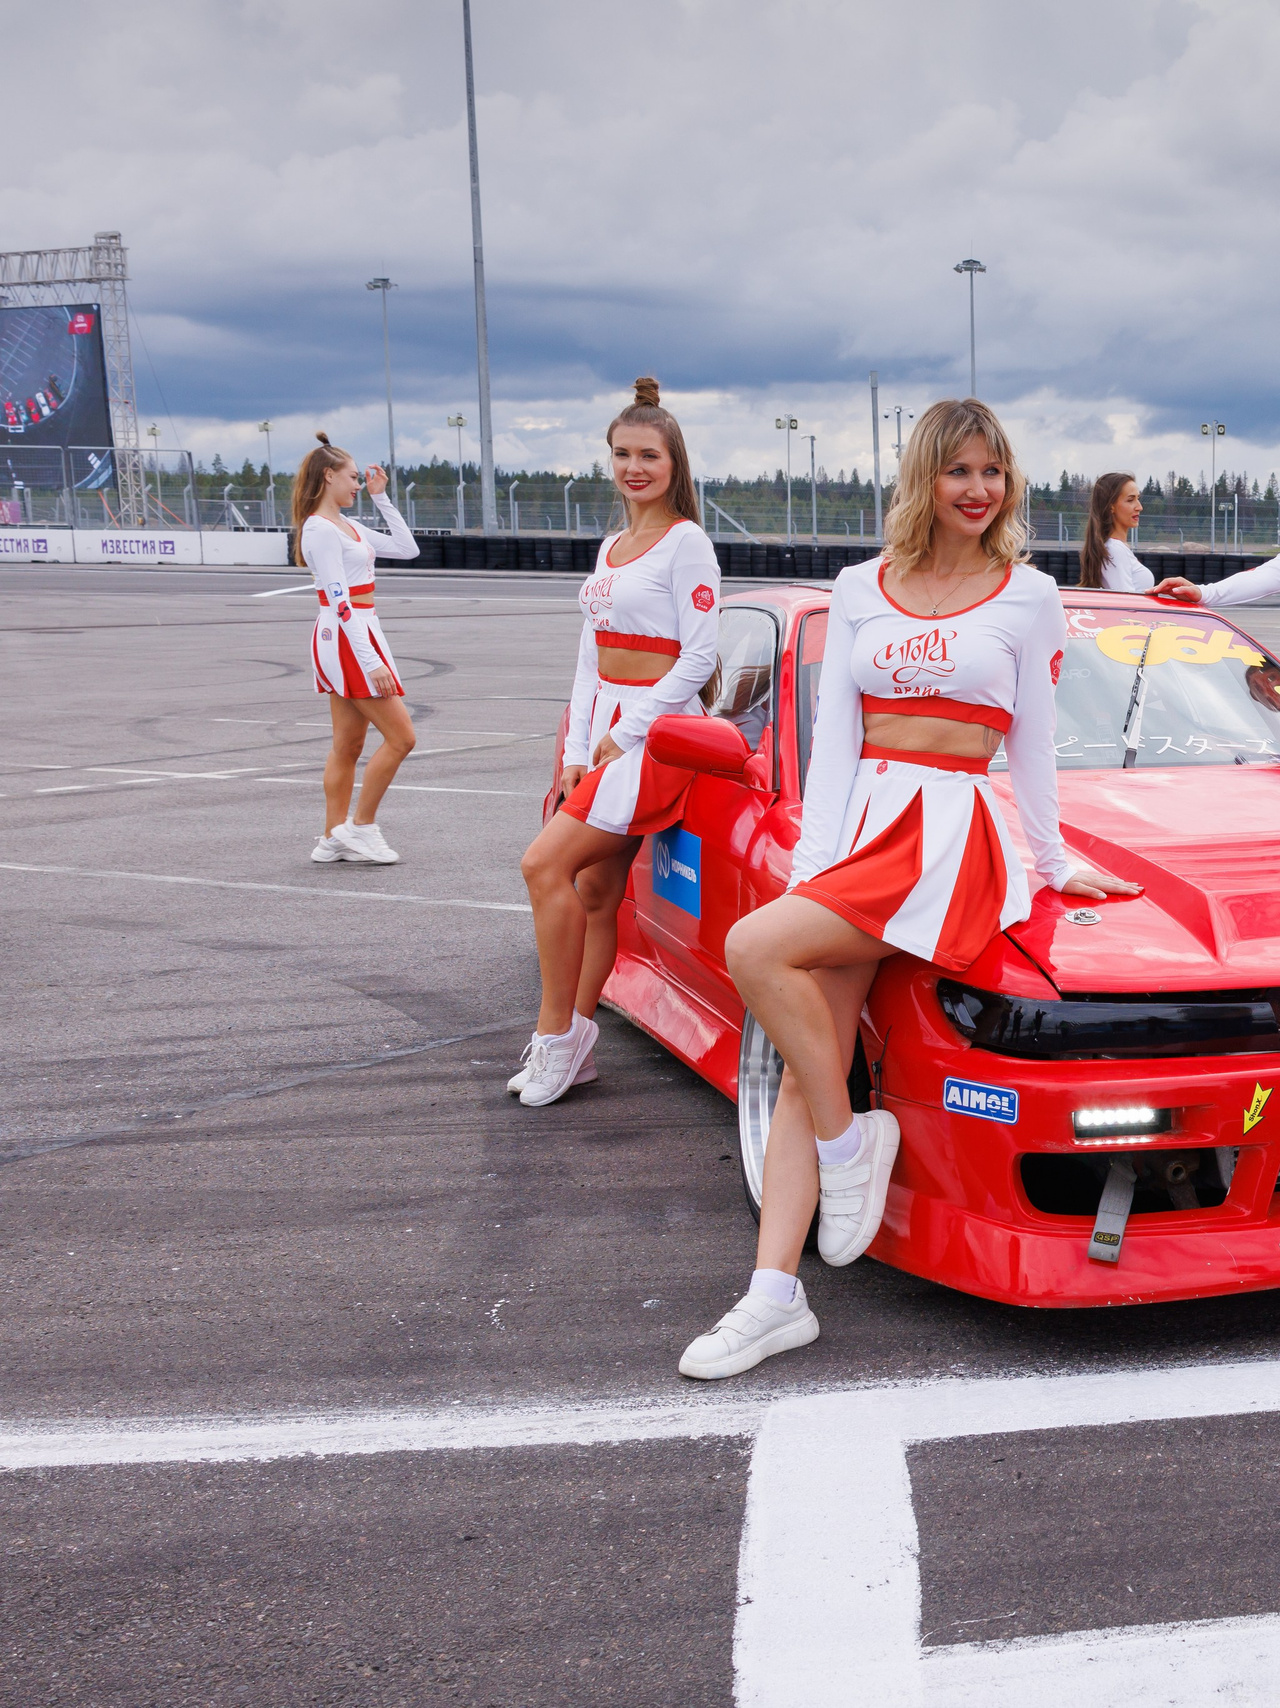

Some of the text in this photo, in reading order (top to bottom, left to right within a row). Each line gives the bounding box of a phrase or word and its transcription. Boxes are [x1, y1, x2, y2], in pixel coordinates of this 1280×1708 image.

[101, 540, 156, 554] ИЗВЕСТИЯ
[1096, 625, 1267, 667] 664
[893, 685, 941, 696] ДРАЙВ
[946, 1086, 1014, 1116] AIMOL
[1096, 1232, 1119, 1243] QSP
